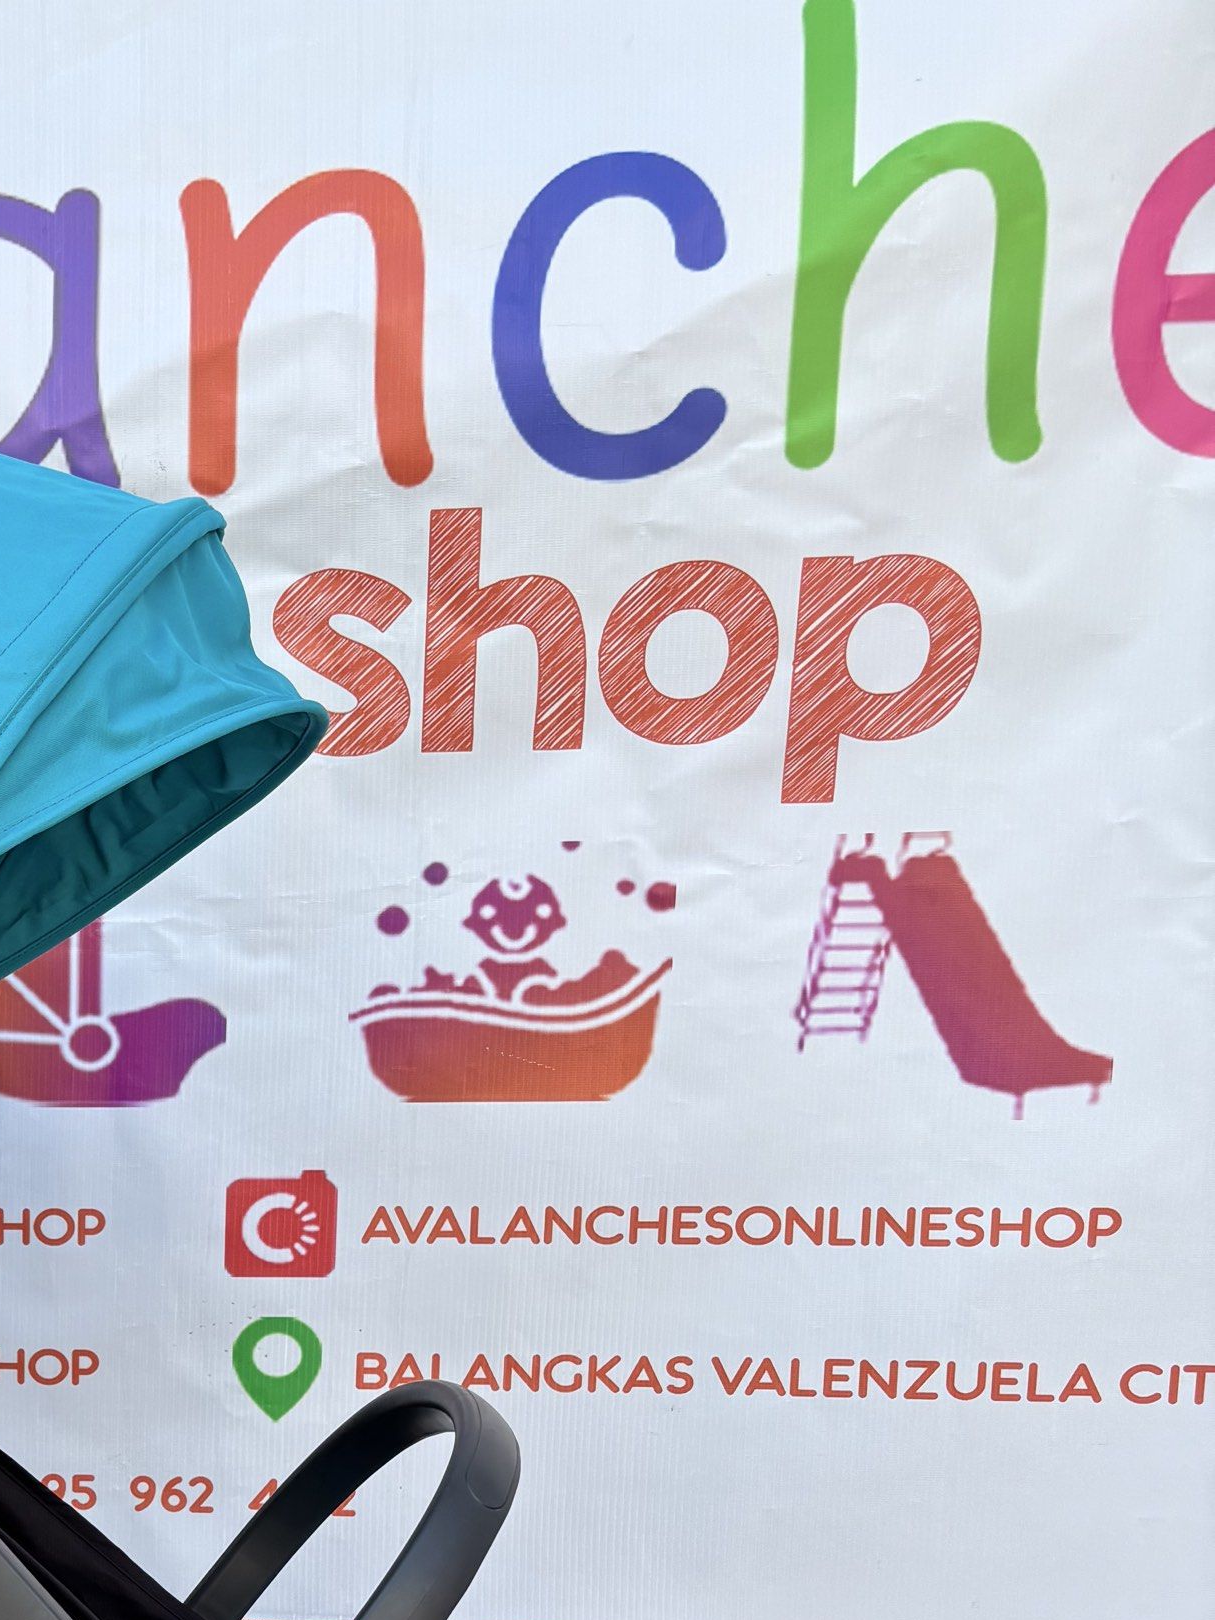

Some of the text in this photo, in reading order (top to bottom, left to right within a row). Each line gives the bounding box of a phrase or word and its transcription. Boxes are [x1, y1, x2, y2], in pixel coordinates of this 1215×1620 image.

[272, 507, 983, 804] shop
[361, 1205, 1123, 1248] AVALANCHESONLINESHOP
[711, 1356, 1102, 1404] VALENZUELA
[129, 1475, 215, 1514] 962
